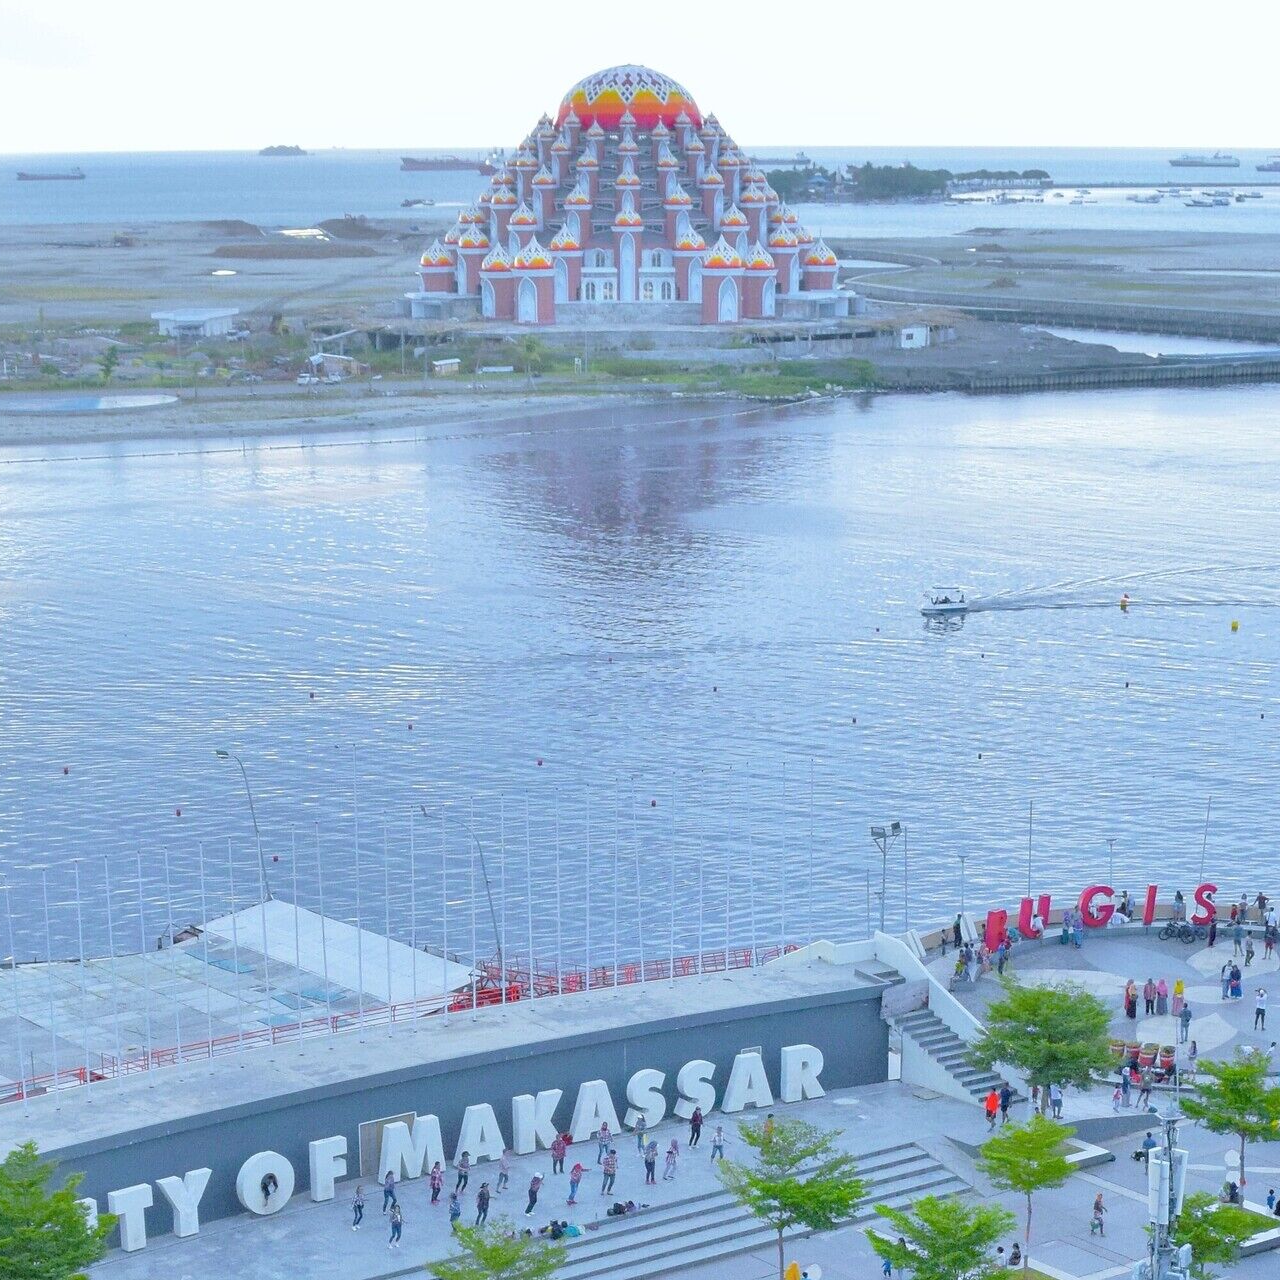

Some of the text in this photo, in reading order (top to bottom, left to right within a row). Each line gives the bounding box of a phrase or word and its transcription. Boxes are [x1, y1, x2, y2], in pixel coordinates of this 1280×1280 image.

[985, 883, 1218, 953] BUGIS
[236, 1151, 347, 1215] OF
[378, 1043, 826, 1185] MAKASSAR
